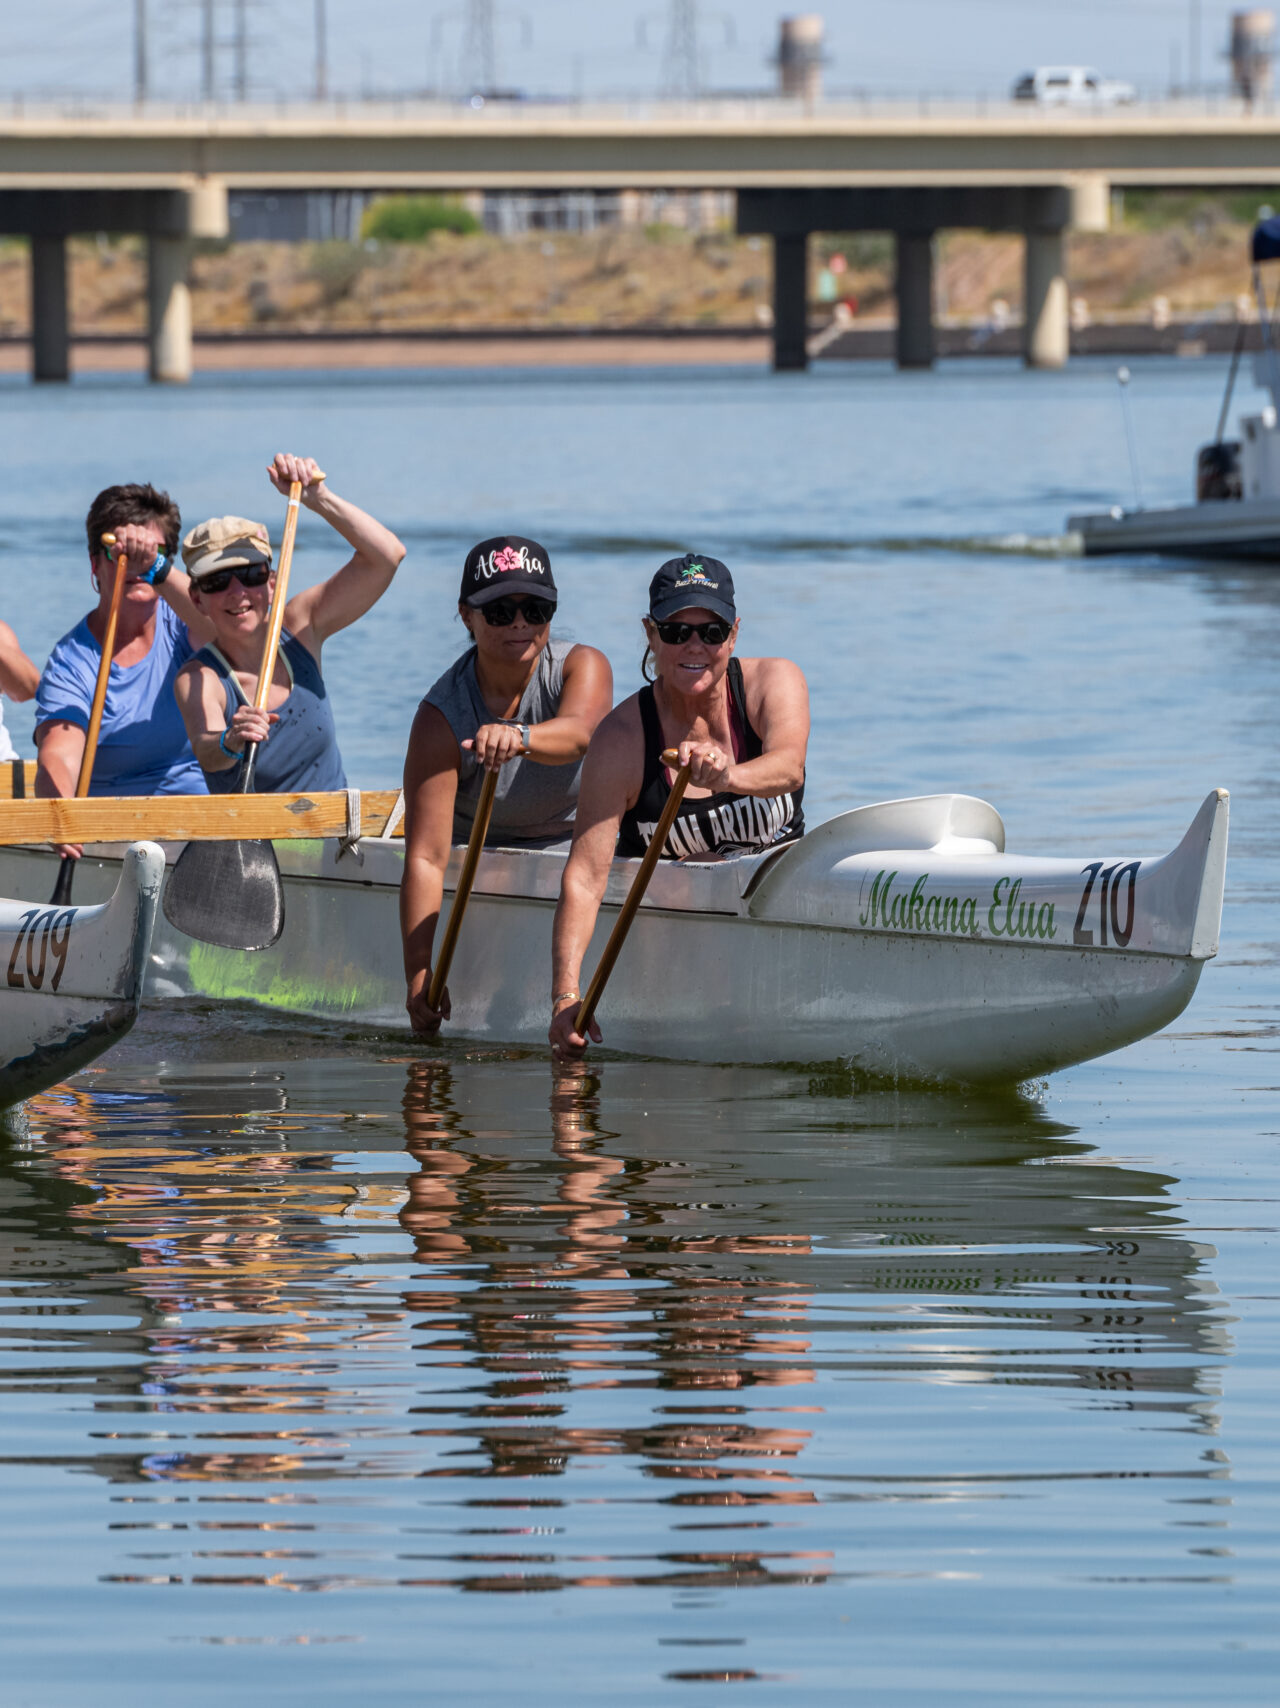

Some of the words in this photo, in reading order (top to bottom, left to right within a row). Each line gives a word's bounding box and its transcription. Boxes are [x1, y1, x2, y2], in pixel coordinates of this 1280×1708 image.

[708, 792, 795, 845] ARIZONA
[858, 868, 979, 934] Makana
[987, 876, 1058, 939] Elua
[1073, 861, 1142, 947] 210
[7, 908, 79, 992] 209
